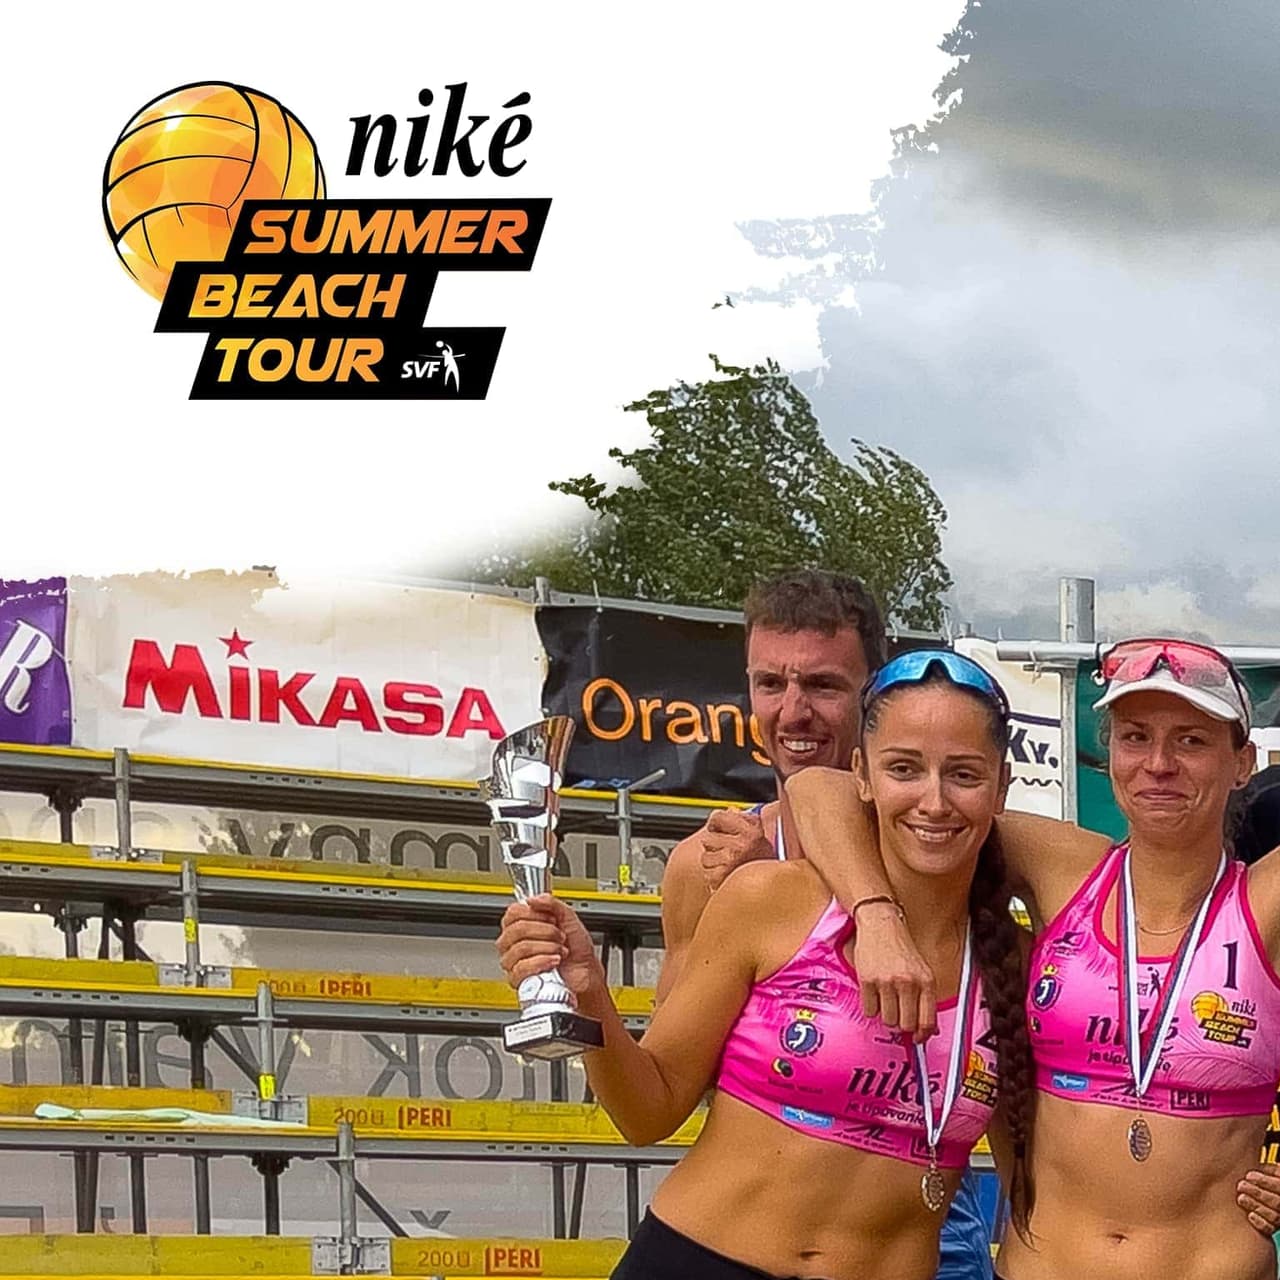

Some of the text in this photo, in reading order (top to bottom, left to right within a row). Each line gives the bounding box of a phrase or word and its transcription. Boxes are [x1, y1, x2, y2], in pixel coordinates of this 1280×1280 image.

[582, 677, 771, 766] Oran
[1223, 941, 1239, 990] 1
[406, 1108, 450, 1127] PERI
[419, 1250, 542, 1269] 200 PERI
